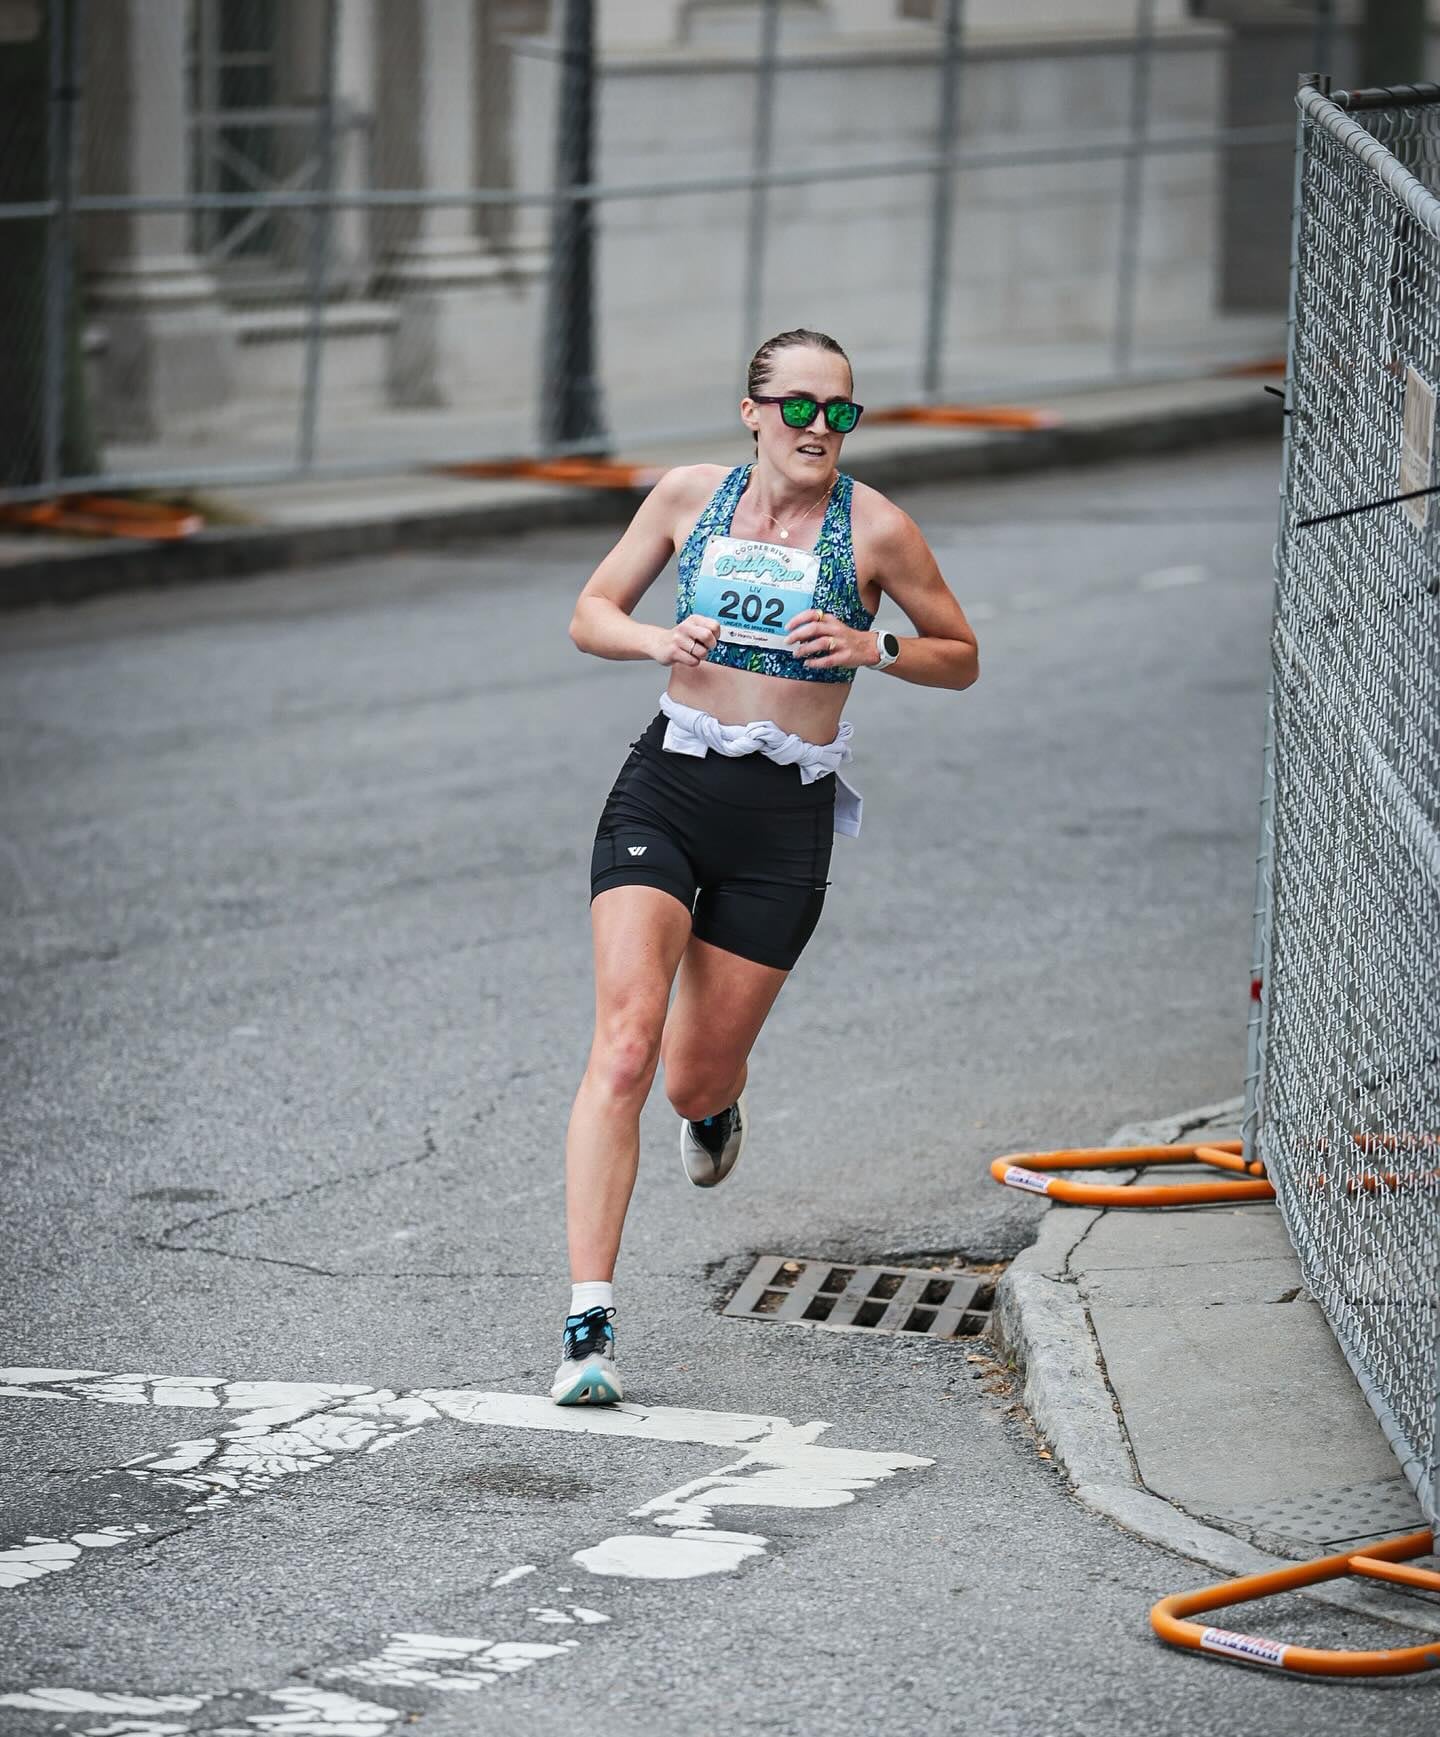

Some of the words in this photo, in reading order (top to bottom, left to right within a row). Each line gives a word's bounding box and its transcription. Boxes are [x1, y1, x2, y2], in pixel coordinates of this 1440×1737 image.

[735, 545, 769, 556] COOPER
[769, 548, 792, 564] RIVER
[715, 553, 781, 578] Bridge
[772, 565, 805, 583] Run
[718, 590, 785, 628] 202
[723, 620, 742, 628] UNDER
[751, 625, 775, 633] MINUTES
